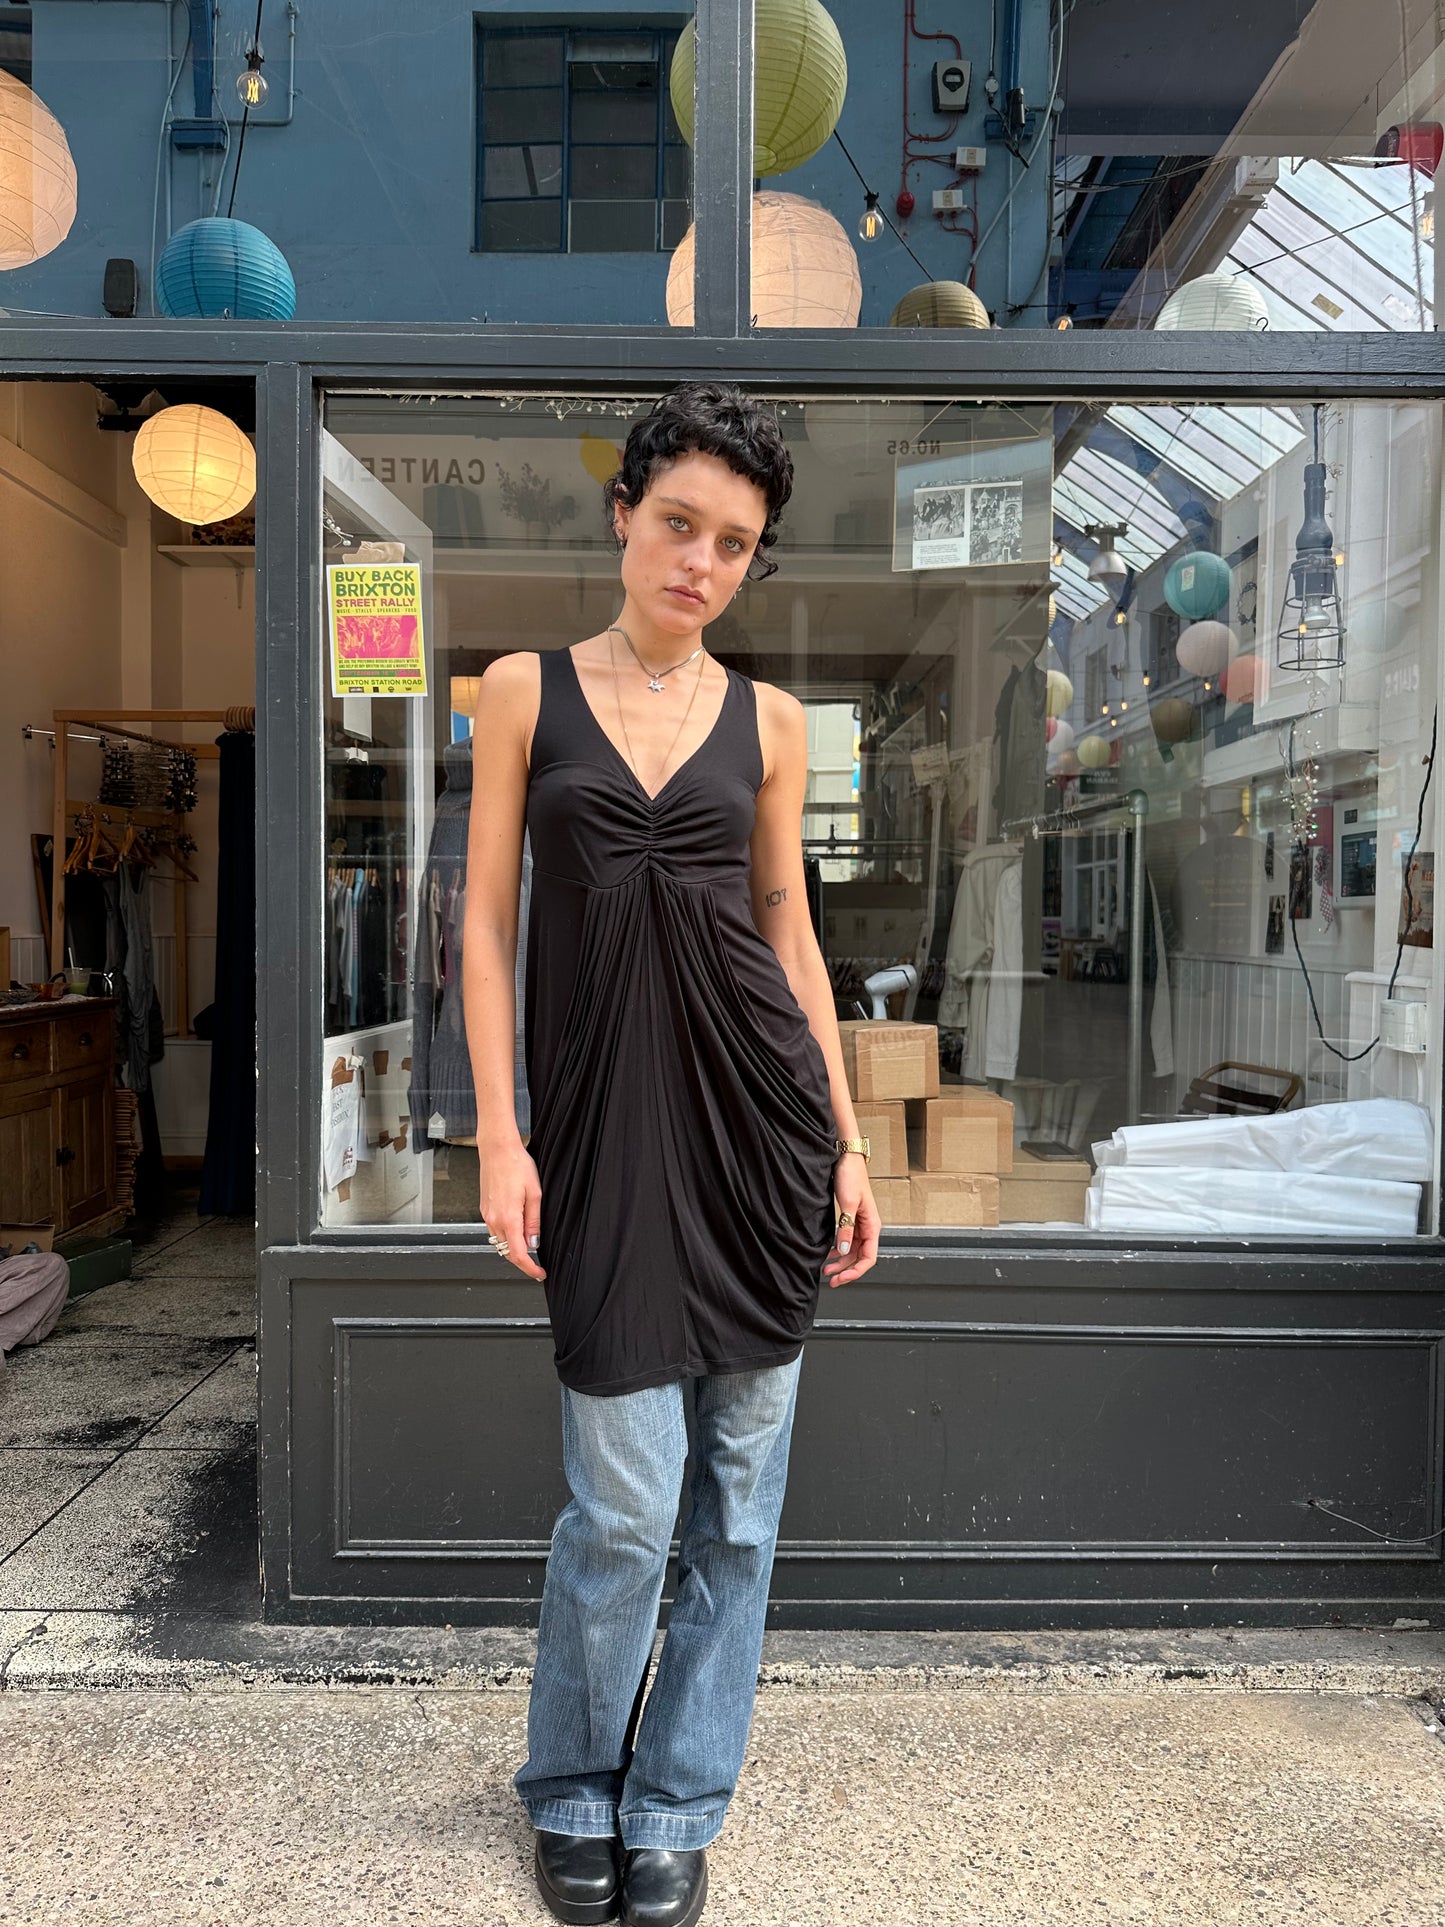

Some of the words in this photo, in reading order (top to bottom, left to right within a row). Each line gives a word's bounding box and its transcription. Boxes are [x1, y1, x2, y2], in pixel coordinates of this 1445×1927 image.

[335, 570, 367, 582] BUY
[371, 569, 414, 582] BACK
[336, 582, 415, 597] BRIXTON
[336, 598, 377, 608] STREET
[380, 597, 415, 607] RALLY
